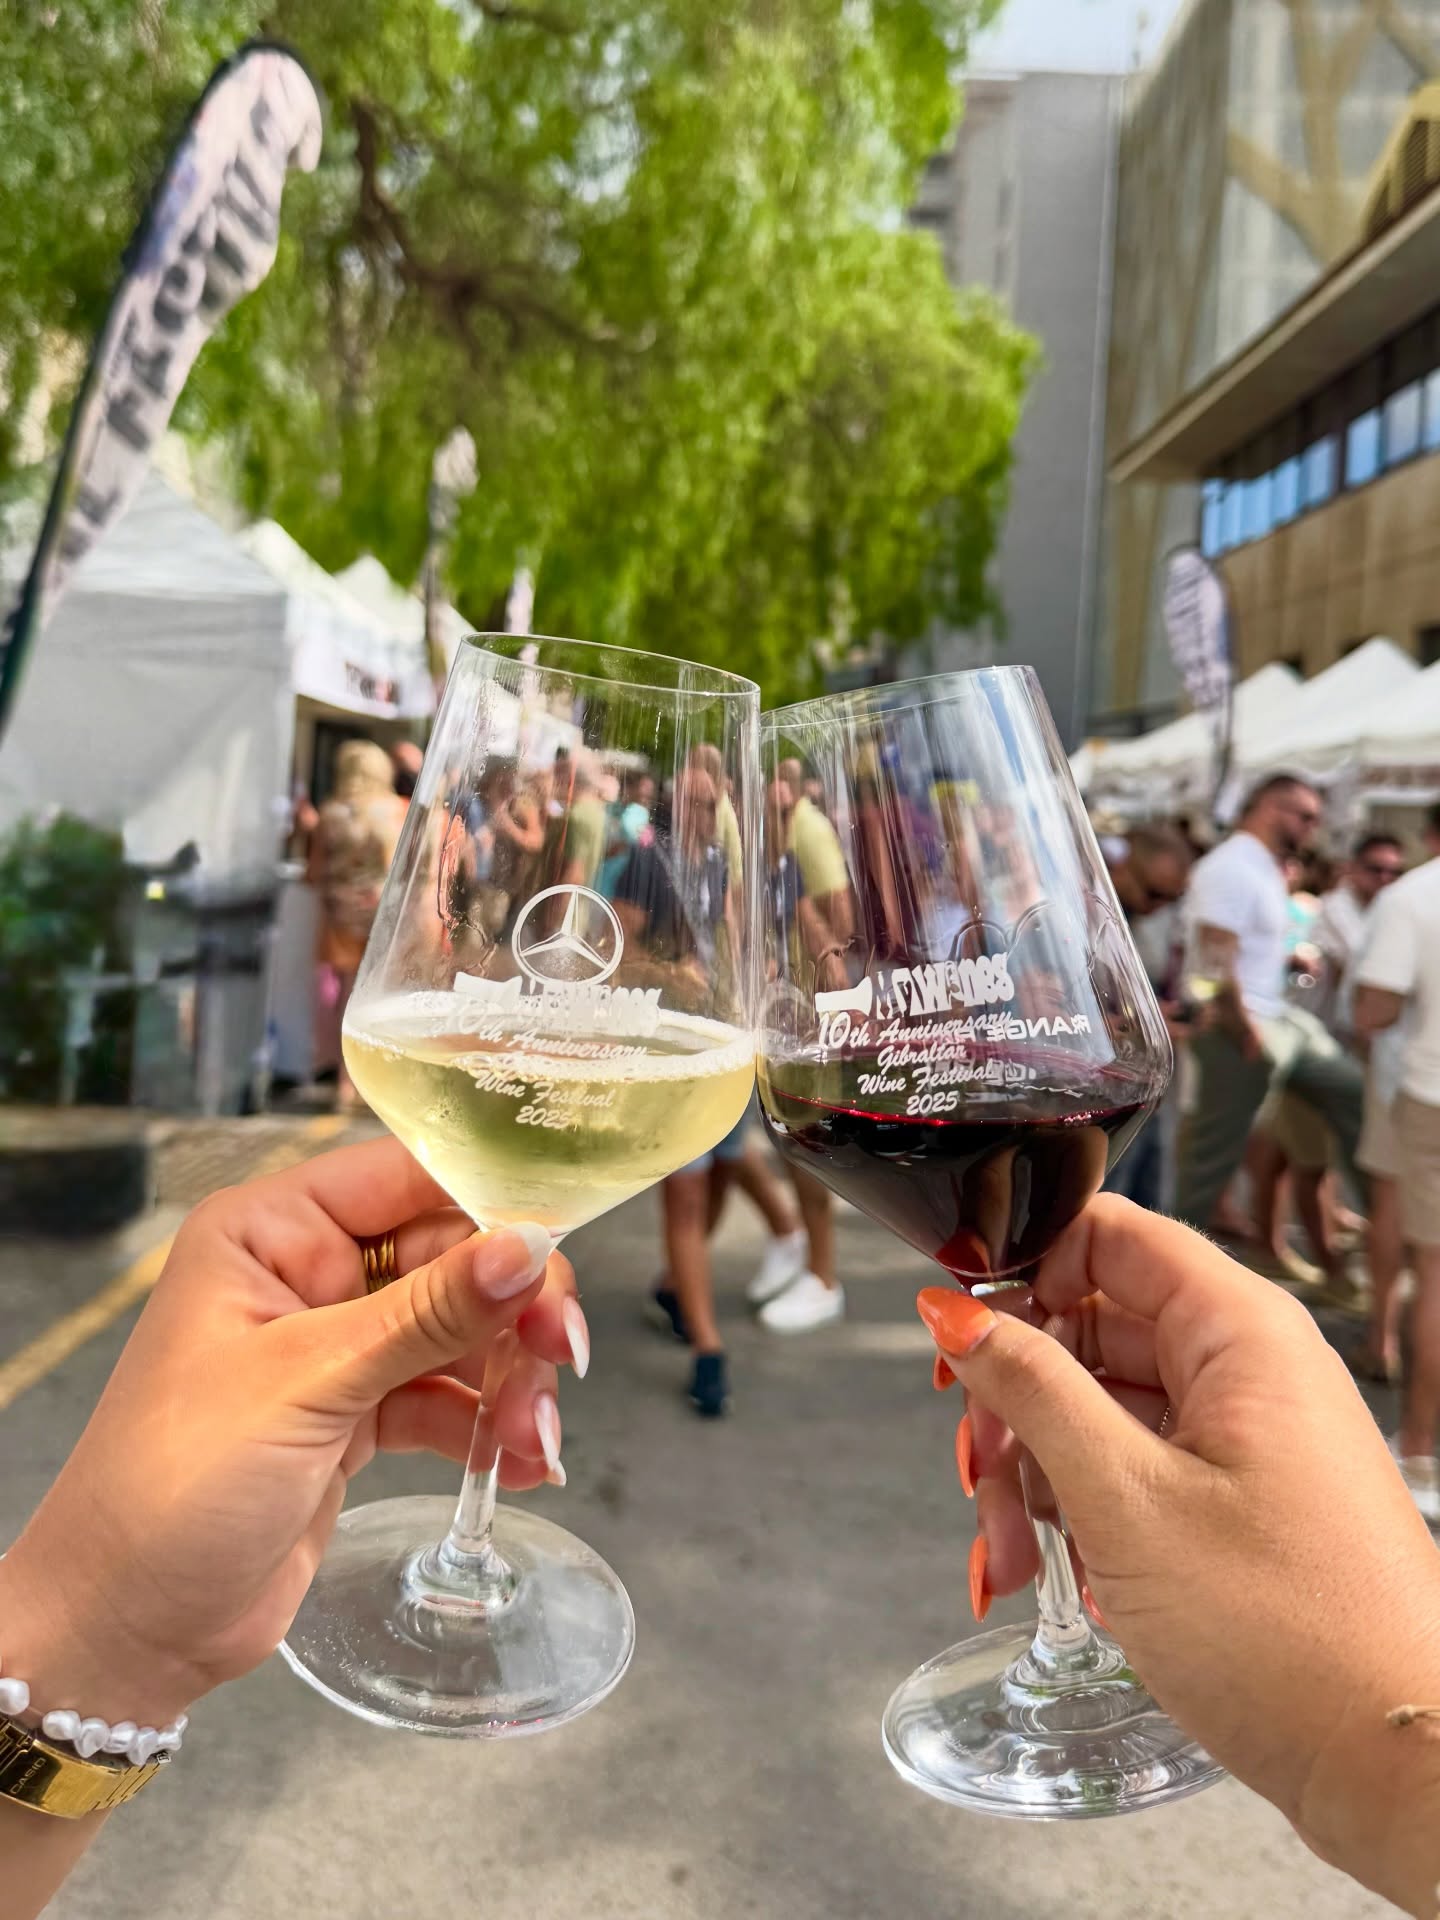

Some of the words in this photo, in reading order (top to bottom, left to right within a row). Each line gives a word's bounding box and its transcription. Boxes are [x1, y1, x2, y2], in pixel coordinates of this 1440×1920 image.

[817, 1012, 871, 1050] 10th
[876, 1010, 1015, 1046] Anniversary
[877, 1041, 967, 1073] Gibraltar
[475, 1068, 526, 1098] Wine
[531, 1081, 616, 1107] Festival
[857, 1072, 907, 1095] Wine
[912, 1060, 994, 1093] Festival
[515, 1105, 571, 1129] 2025
[906, 1090, 960, 1115] 2025
[9, 1757, 46, 1794] CASIO
